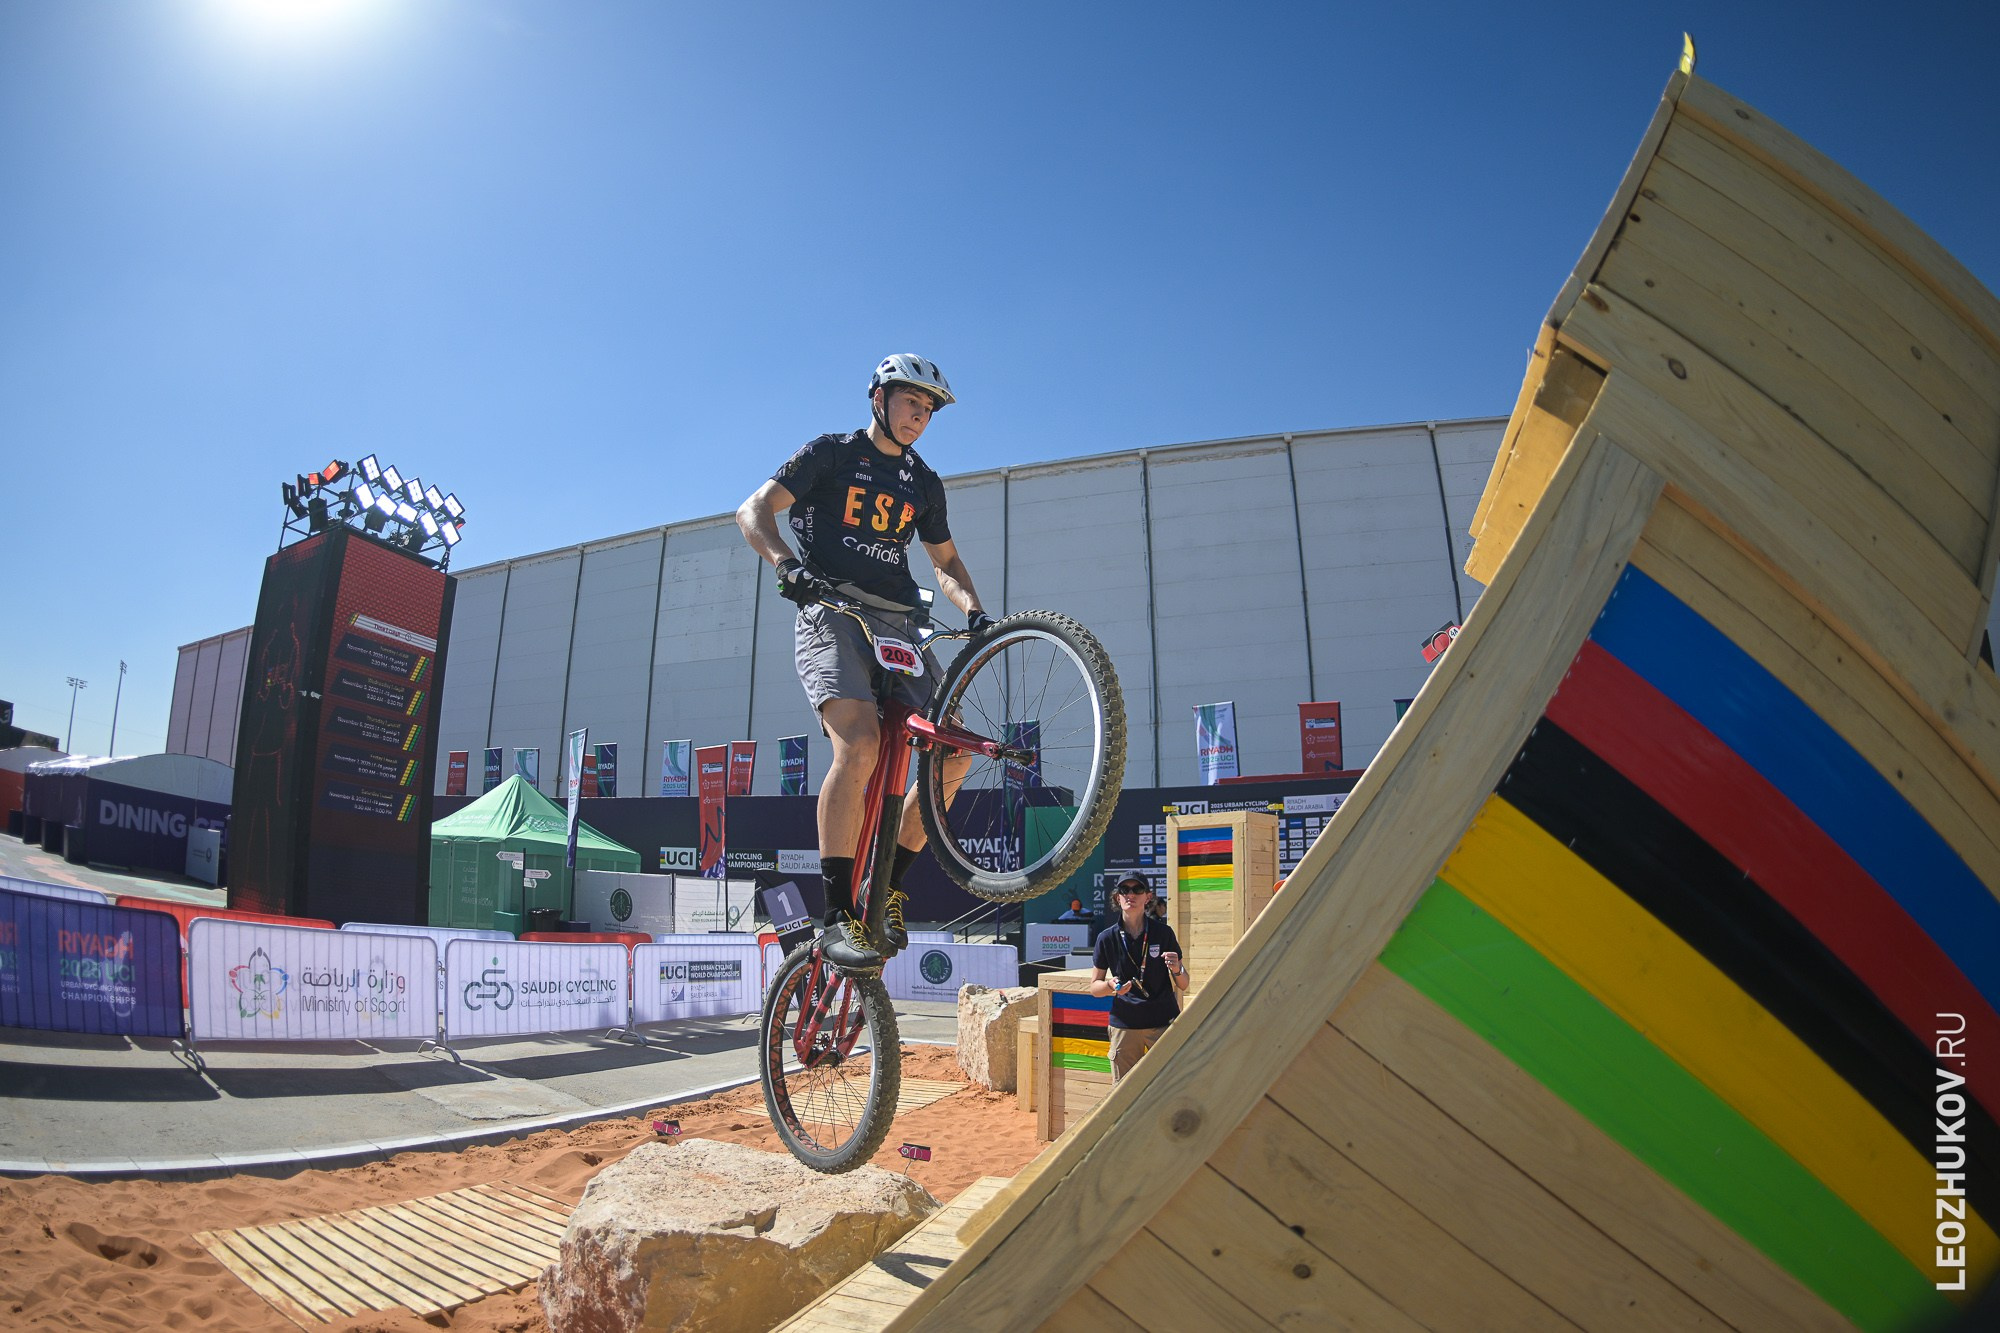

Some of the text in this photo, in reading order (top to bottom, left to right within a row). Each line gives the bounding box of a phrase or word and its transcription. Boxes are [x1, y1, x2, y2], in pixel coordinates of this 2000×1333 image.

[855, 472, 872, 482] GOBIK
[842, 536, 900, 565] Cofidis
[884, 648, 913, 666] 203
[1200, 745, 1233, 756] RIYADH
[780, 757, 805, 767] RIYADH
[1201, 754, 1234, 764] 2025 UCI
[1177, 803, 1206, 815] UCI
[100, 799, 187, 838] DINING
[666, 851, 694, 866] UCI
[726, 861, 775, 869] HAMPIONSHIPS
[800, 862, 821, 870] ARABI
[777, 891, 793, 917] 1
[783, 920, 802, 933] UCI
[58, 929, 135, 961] RIYADH
[1042, 935, 1070, 943] RIYADH
[60, 958, 136, 983] 2025 UCI
[665, 965, 687, 980] UCI
[706, 970, 740, 978] CHAMPIONSHIPS
[61, 980, 84, 990] URBAN
[114, 984, 137, 994] WORLD
[302, 967, 406, 994] وزارة الرياضة
[520, 979, 617, 994] SAUDI CYCLING
[61, 991, 137, 1005] CHAMPIONSHIPS
[302, 995, 406, 1016] Ministry of Sport
